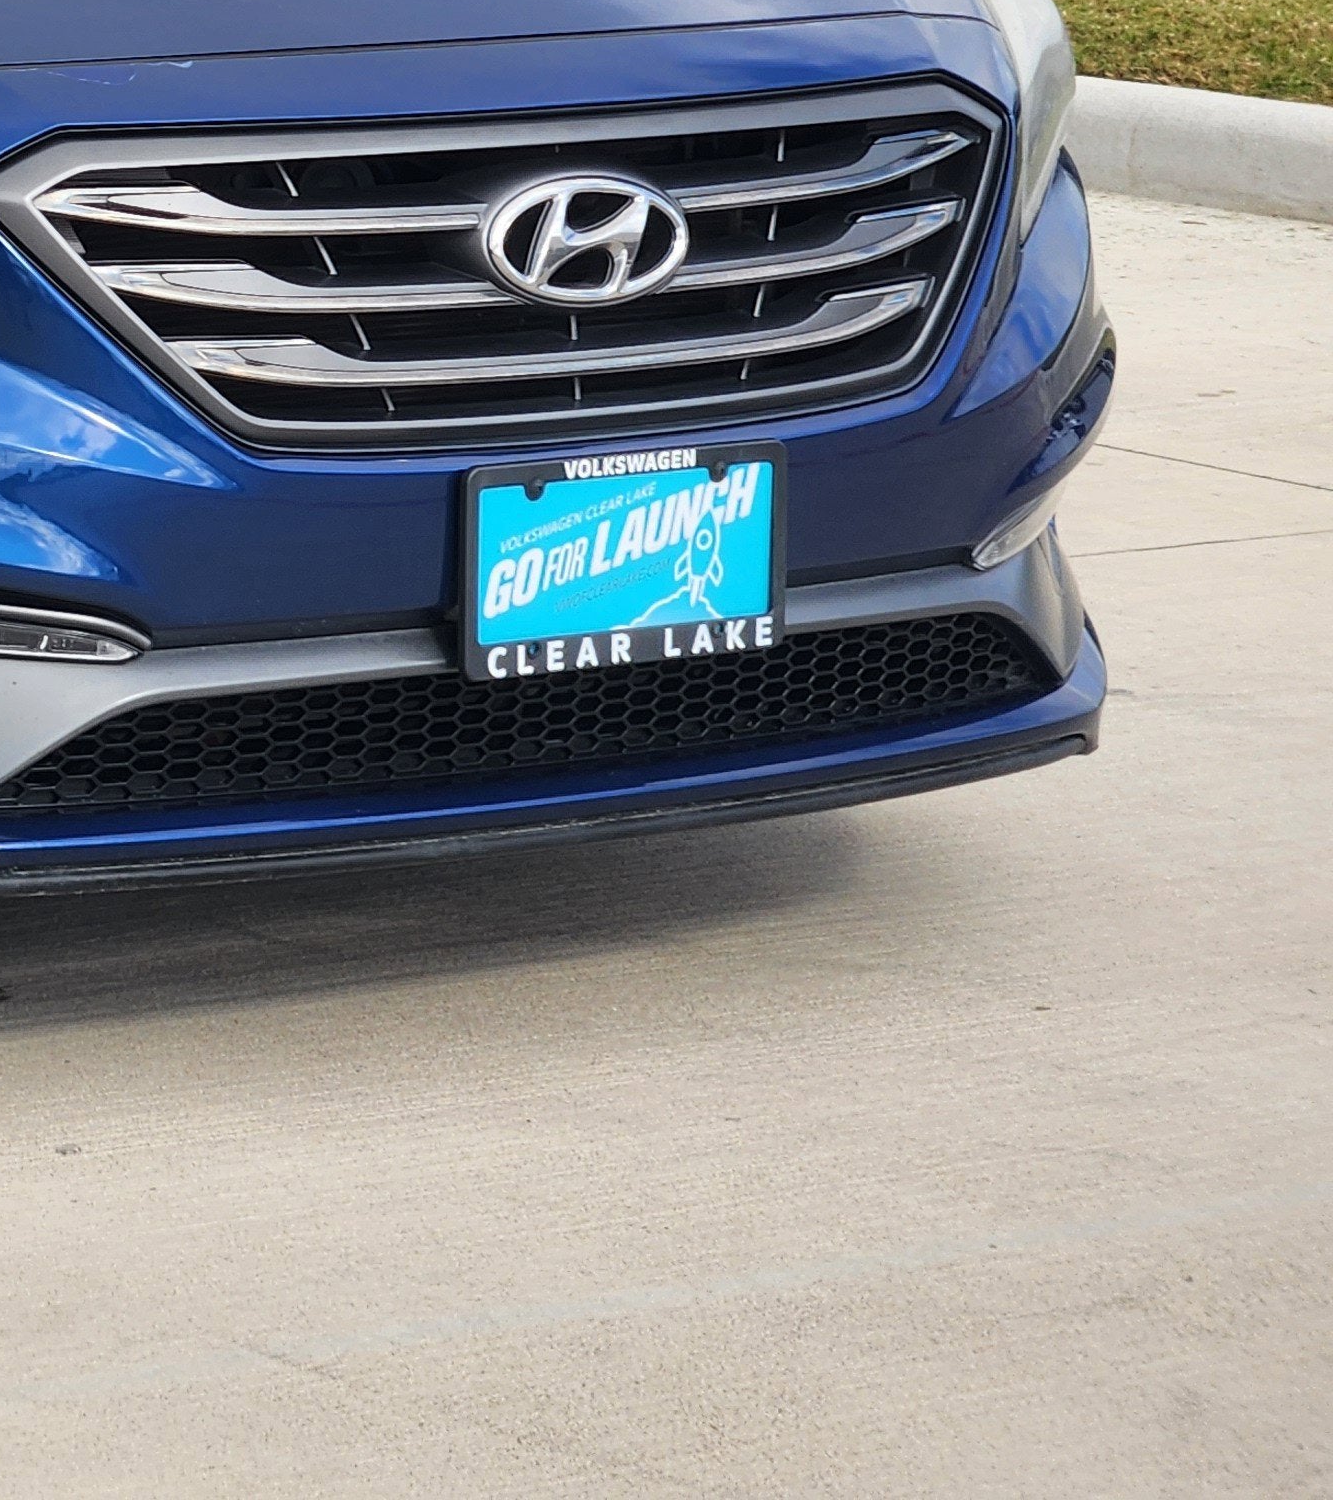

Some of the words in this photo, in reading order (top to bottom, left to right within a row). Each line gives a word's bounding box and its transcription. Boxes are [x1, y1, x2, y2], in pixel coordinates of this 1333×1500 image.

[564, 449, 697, 479] VOLKSWAGEN
[483, 547, 545, 619] GO
[542, 536, 589, 592] FOR
[589, 462, 760, 577] LAUNCH
[500, 510, 583, 554] VOLKSWAGEN
[585, 494, 625, 521] CLEAR
[626, 481, 658, 506] LAKE
[487, 632, 632, 679] CLEAR
[663, 616, 775, 658] LAKE
